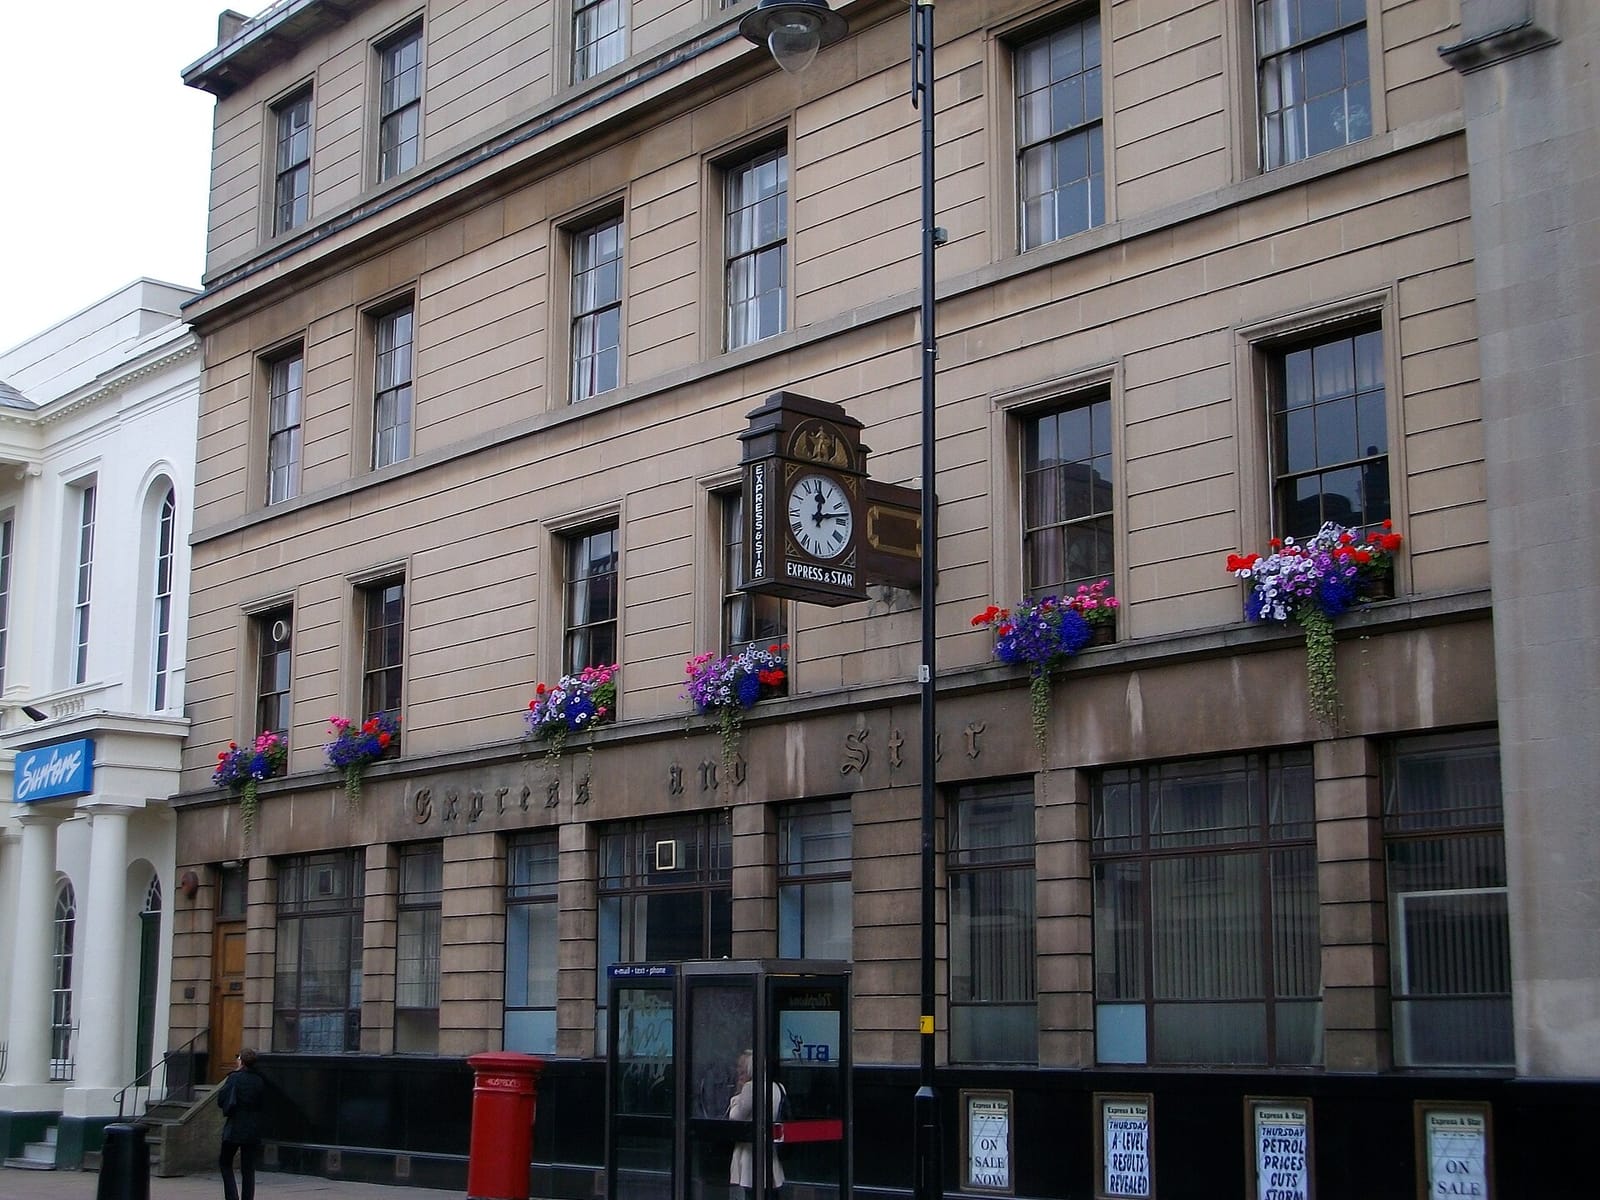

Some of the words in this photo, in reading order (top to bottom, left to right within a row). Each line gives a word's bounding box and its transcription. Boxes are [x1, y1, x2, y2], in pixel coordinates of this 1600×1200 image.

[755, 465, 763, 530] EXPRESS
[755, 531, 762, 540] &
[755, 541, 763, 578] STAR
[787, 562, 823, 581] EXPRESS
[824, 572, 830, 583] &
[831, 570, 853, 587] STAR
[840, 721, 987, 775] Str
[1109, 1121, 1147, 1130] THURSDAY
[1262, 1127, 1305, 1137] THURSDAY
[981, 1138, 998, 1151] ON
[1262, 1138, 1304, 1154] PETROL
[975, 1156, 1005, 1168] SALE
[1112, 1153, 1145, 1172] RESULTS
[1264, 1155, 1304, 1171] PRICES
[1446, 1160, 1470, 1174] ON
[975, 1173, 1005, 1186] NOW
[1110, 1174, 1147, 1194] REVEALED
[1270, 1172, 1298, 1187] CUTS
[1437, 1181, 1482, 1196] SALE
